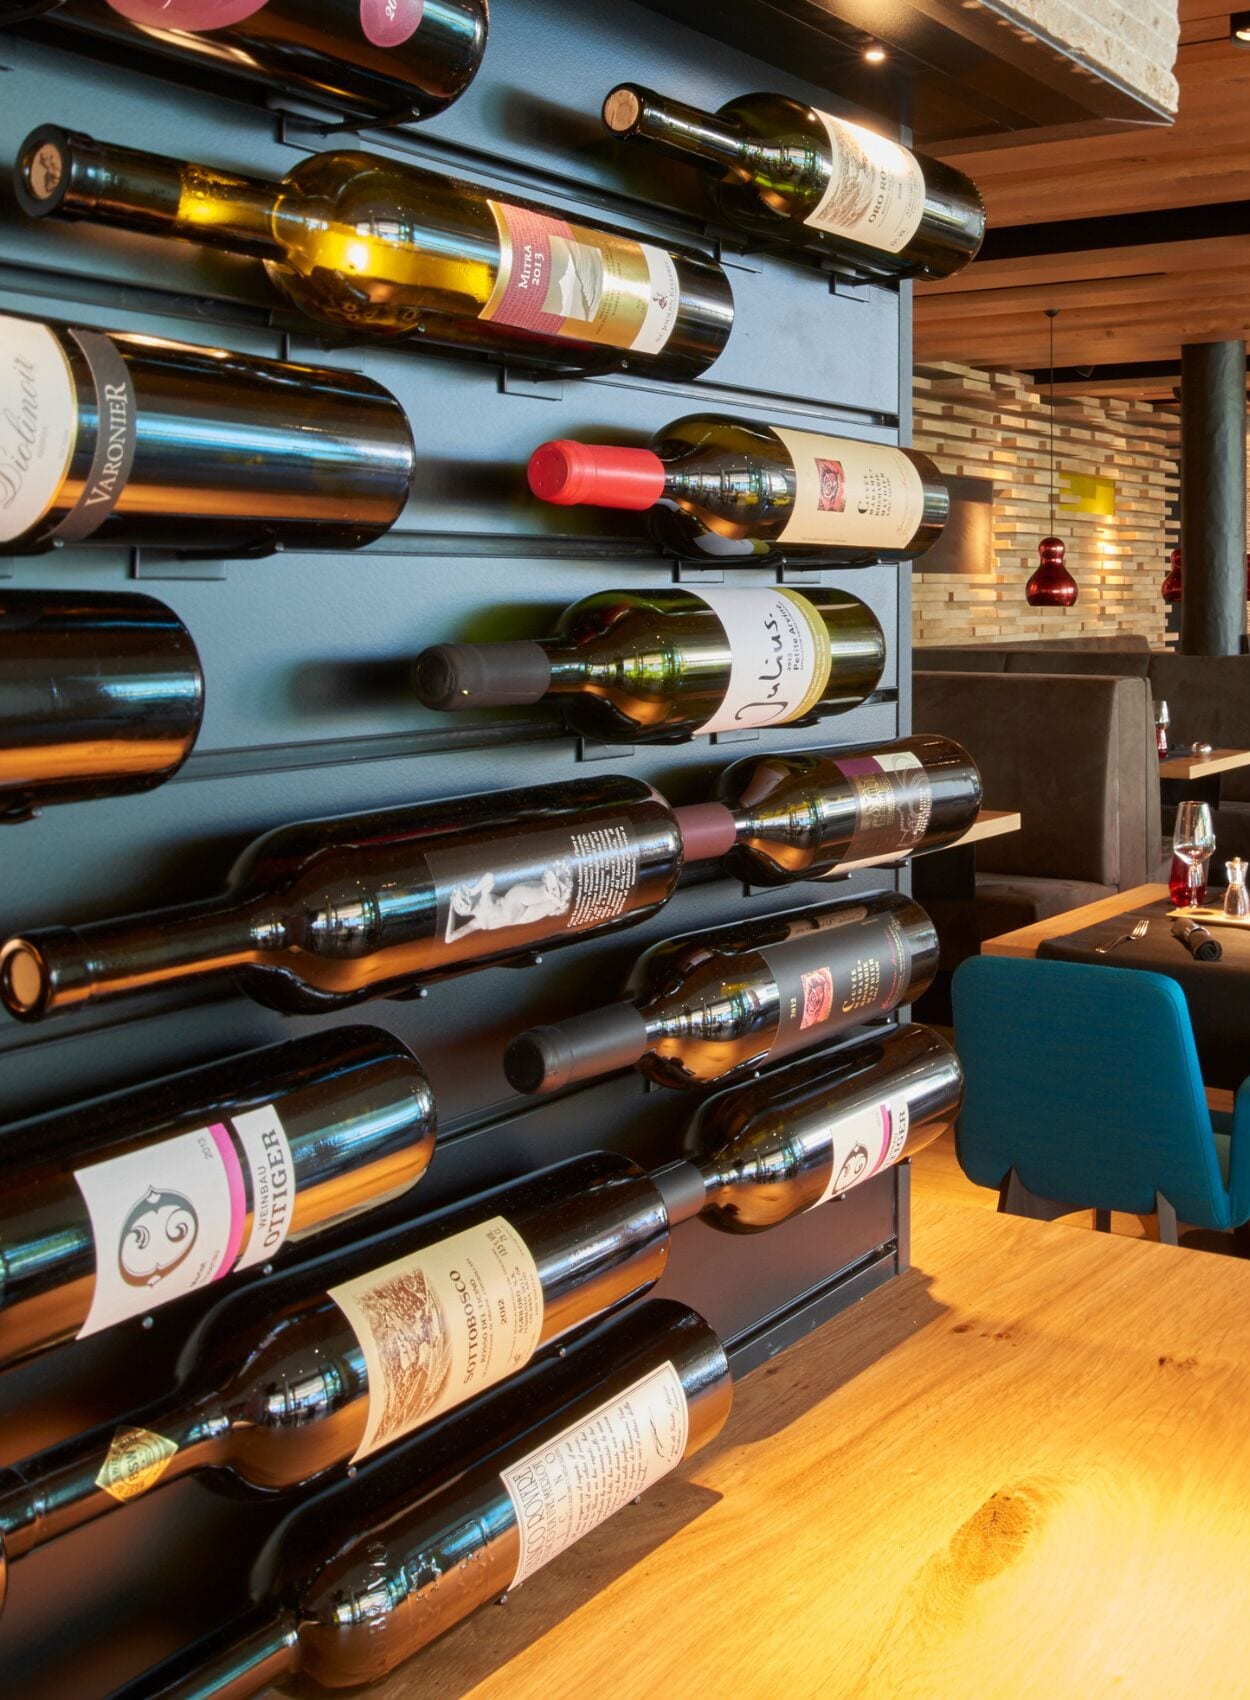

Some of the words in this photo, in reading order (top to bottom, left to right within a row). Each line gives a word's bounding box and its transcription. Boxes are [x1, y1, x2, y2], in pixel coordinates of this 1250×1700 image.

[518, 245, 532, 289] MITRA
[532, 253, 545, 286] 2013
[84, 382, 128, 507] VARONIER
[257, 1165, 270, 1231] WEINBAU
[262, 1129, 287, 1247] OTTIGER
[450, 1270, 479, 1384] SOTTOBOSCO
[498, 1298, 508, 1325] 2012
[480, 1331, 488, 1364] ROSSO
[512, 1467, 545, 1529] ROVERE
[532, 1460, 552, 1502] MERLOT
